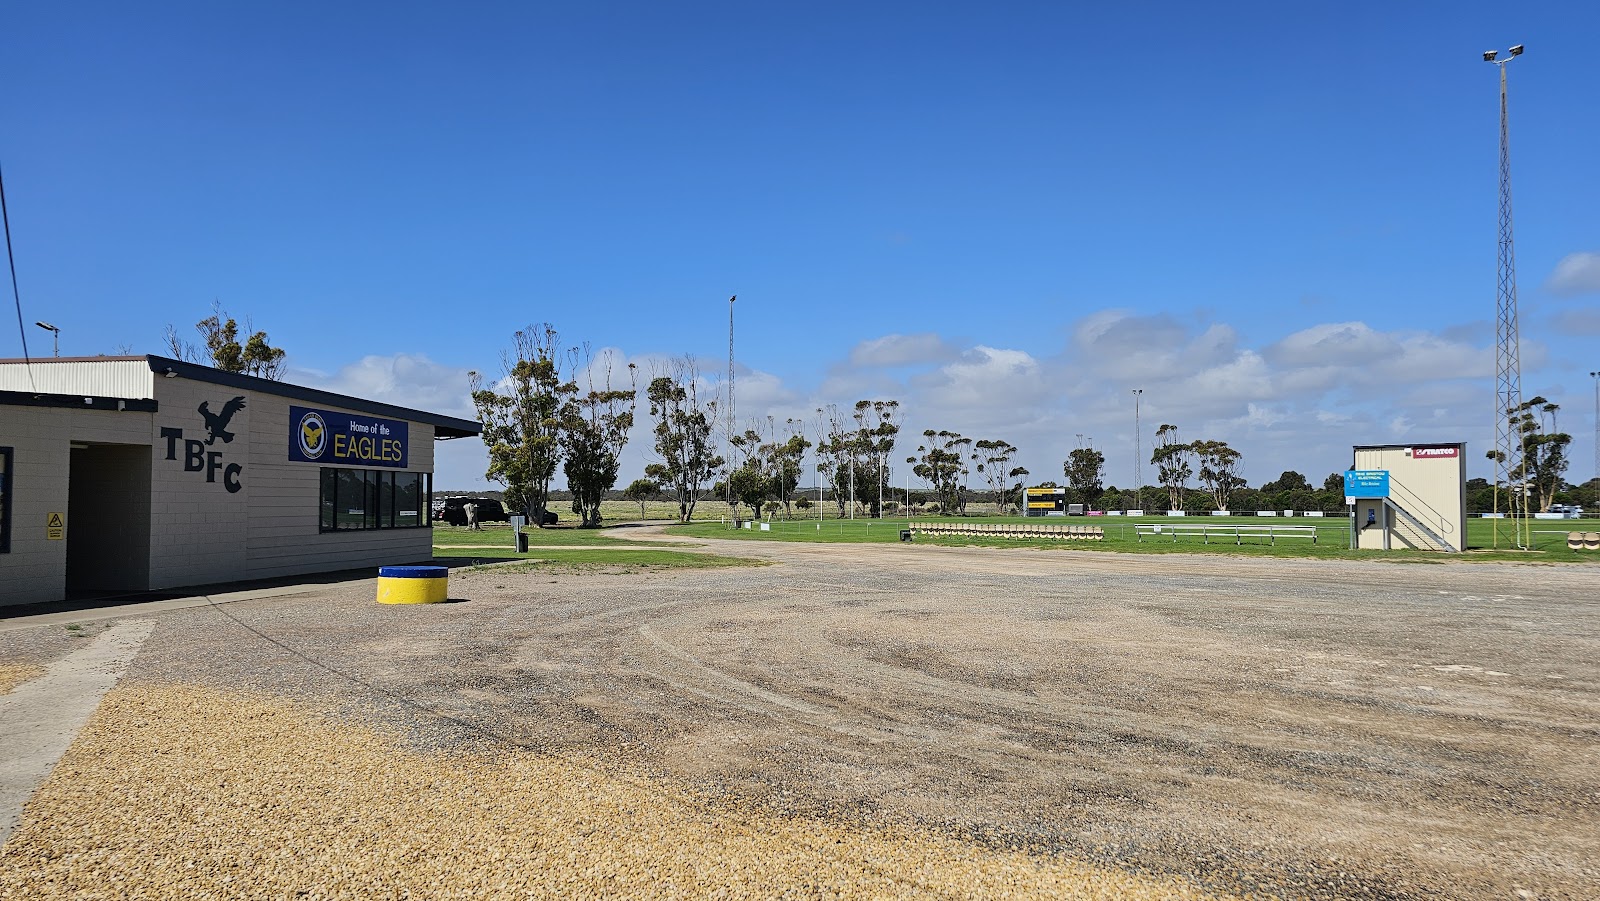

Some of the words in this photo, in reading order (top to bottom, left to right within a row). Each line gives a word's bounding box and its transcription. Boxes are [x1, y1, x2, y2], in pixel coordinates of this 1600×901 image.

[350, 421, 369, 434] Home
[370, 423, 379, 435] of
[379, 423, 390, 436] the
[334, 434, 402, 462] EAGLES
[1420, 448, 1455, 456] STRATCO
[160, 427, 243, 493] TBFC
